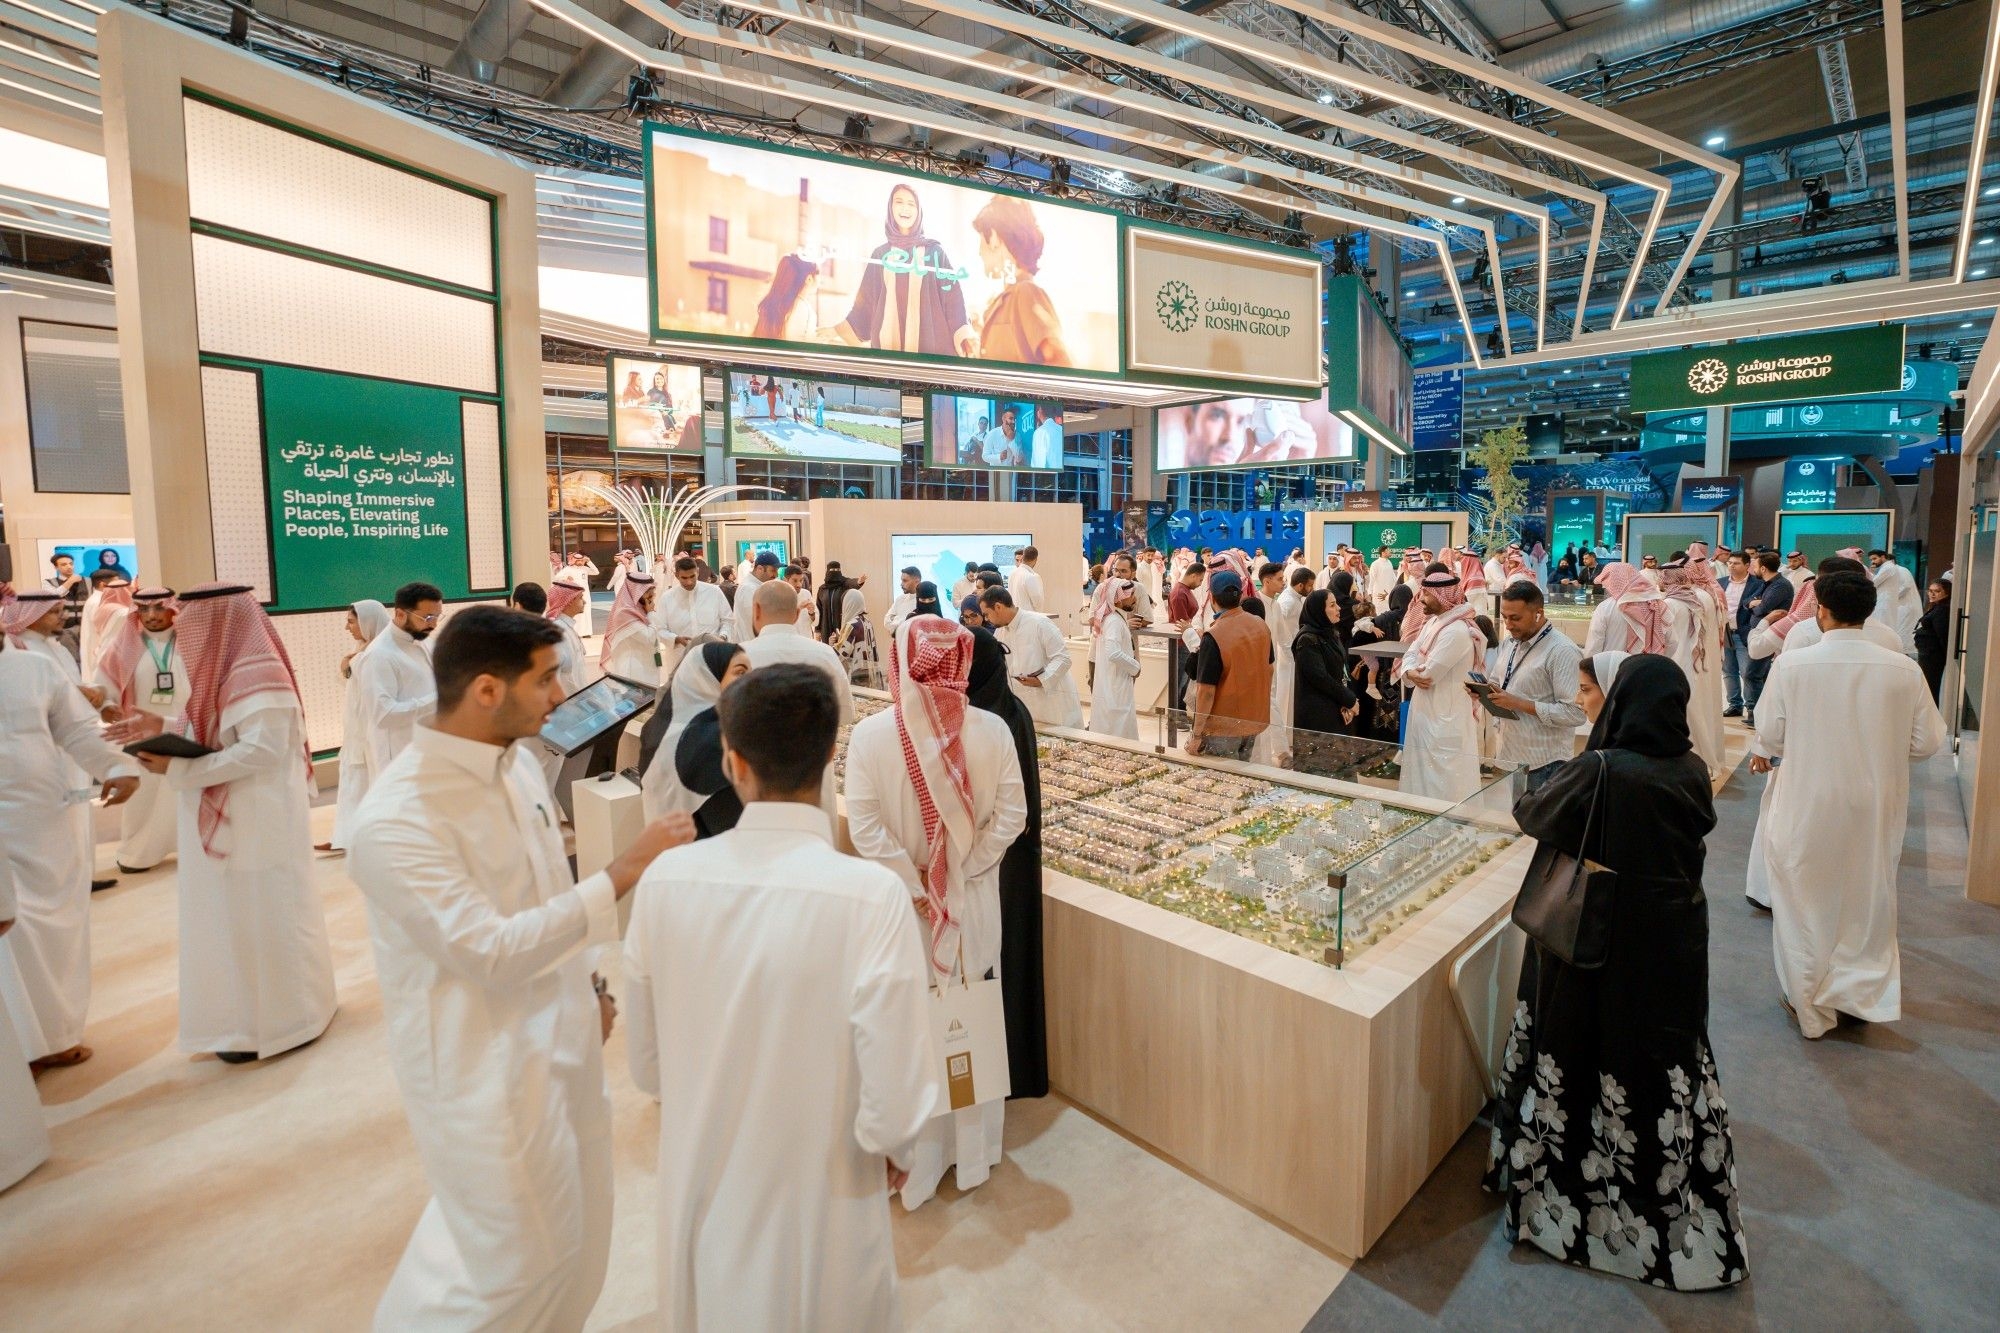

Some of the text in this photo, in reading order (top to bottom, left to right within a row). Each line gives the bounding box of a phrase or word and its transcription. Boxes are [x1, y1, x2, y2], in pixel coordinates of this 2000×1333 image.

[1204, 296, 1291, 321] مجموعة روشن
[1205, 315, 1291, 338] ROSHN GROUP
[1736, 354, 1832, 375] مجموعة روشن
[1736, 366, 1832, 386] ROSHN GROUP
[280, 440, 454, 468] نطور تجارب غامرة، ترتقي
[303, 462, 349, 482] الحياة
[1585, 476, 1612, 486] NEW
[283, 489, 436, 508] Shaping Immersive
[284, 506, 421, 525] Places, Elevating
[285, 523, 449, 540] People, Inspiring Life
